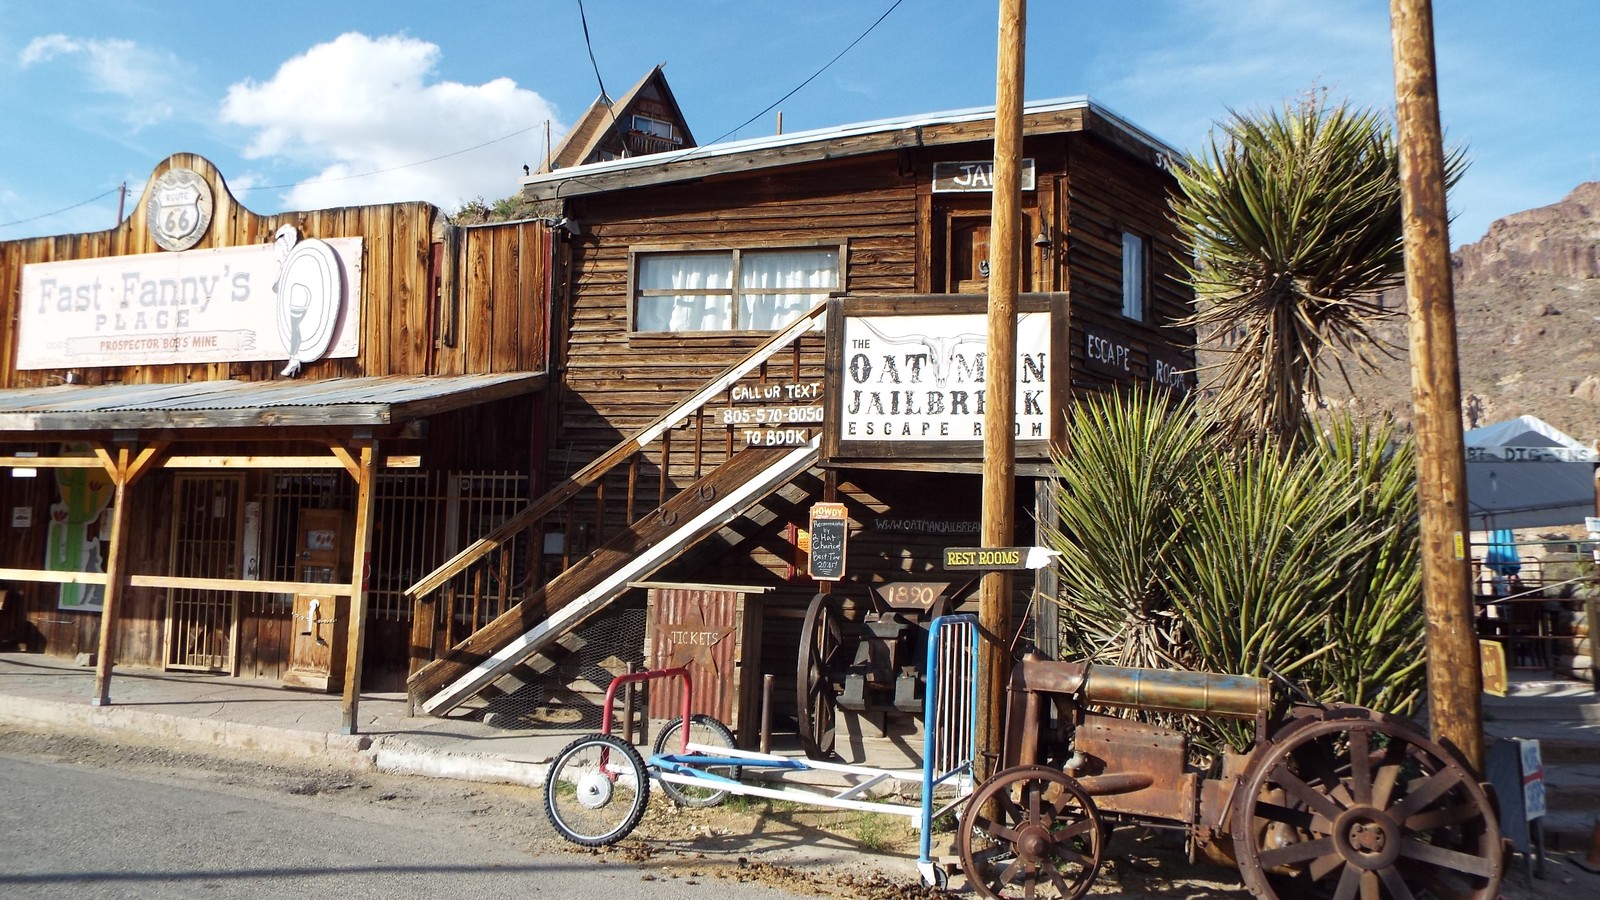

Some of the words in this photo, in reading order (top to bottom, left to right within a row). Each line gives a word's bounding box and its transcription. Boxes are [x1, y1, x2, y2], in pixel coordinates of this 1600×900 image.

[166, 192, 189, 202] ROUTE
[165, 209, 189, 232] 66
[38, 276, 102, 314] Fast
[120, 264, 252, 313] Fanny's
[95, 308, 190, 333] PLACE
[99, 338, 160, 352] PROSPECTOR
[192, 335, 218, 348] MINE
[852, 339, 871, 349] THE
[1088, 334, 1130, 371] ESCAPE
[849, 352, 1046, 385] OATMN
[732, 385, 761, 400] CALL
[785, 382, 820, 398] TEXT
[848, 389, 1044, 415] JAILBREK
[723, 406, 824, 424] 805-570-8050
[744, 430, 761, 445] TO
[766, 429, 806, 446] BOOK
[848, 422, 949, 436] ESCAPE
[973, 422, 1042, 437] ROM
[812, 507, 843, 517] HOWDY
[947, 551, 976, 566] REST
[978, 551, 1019, 565] ROOMS
[888, 586, 934, 605] 1890
[670, 631, 719, 646] TICKETS
